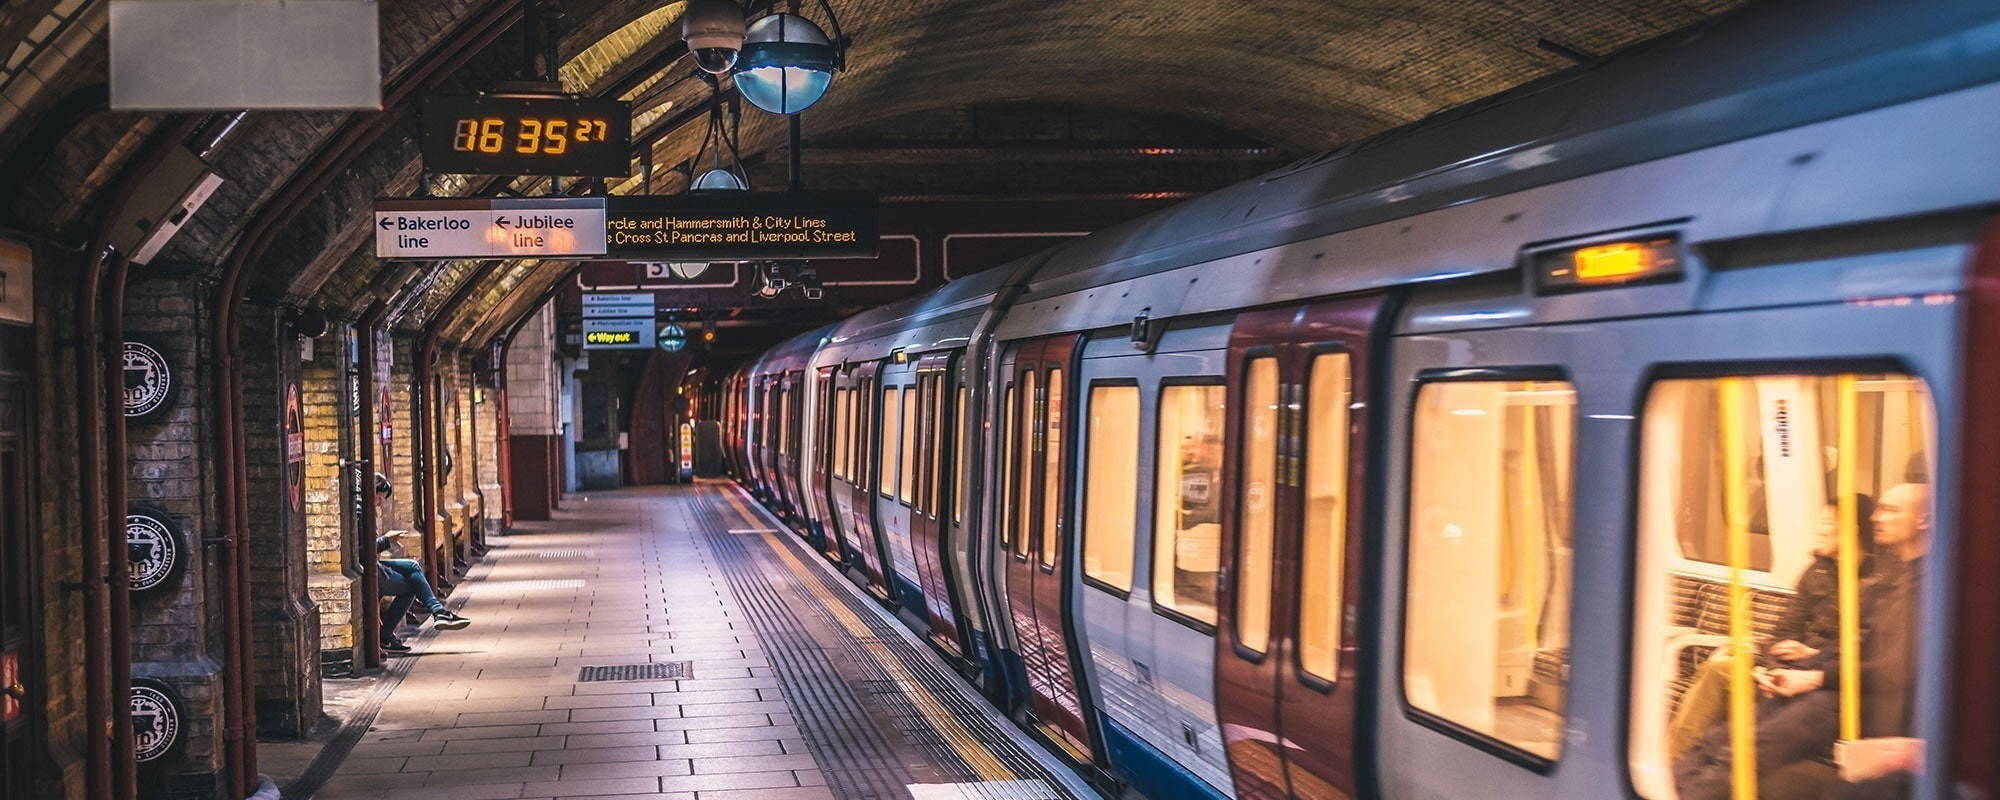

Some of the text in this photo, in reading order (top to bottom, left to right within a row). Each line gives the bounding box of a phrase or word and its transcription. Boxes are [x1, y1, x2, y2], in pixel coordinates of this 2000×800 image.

[466, 119, 607, 155] 16 35 27
[398, 216, 470, 231] Bakerloo
[514, 215, 574, 229] Jubilee
[608, 216, 826, 230] rcle and Hammersmith & City Lines
[398, 235, 429, 248] line
[513, 234, 544, 247] line
[615, 233, 652, 244] Cross
[654, 232, 669, 244] St
[671, 232, 723, 244] Pancras
[725, 231, 749, 242] and
[751, 230, 810, 243] Liverpool
[813, 230, 856, 242] Street
[596, 332, 631, 344] Way out
